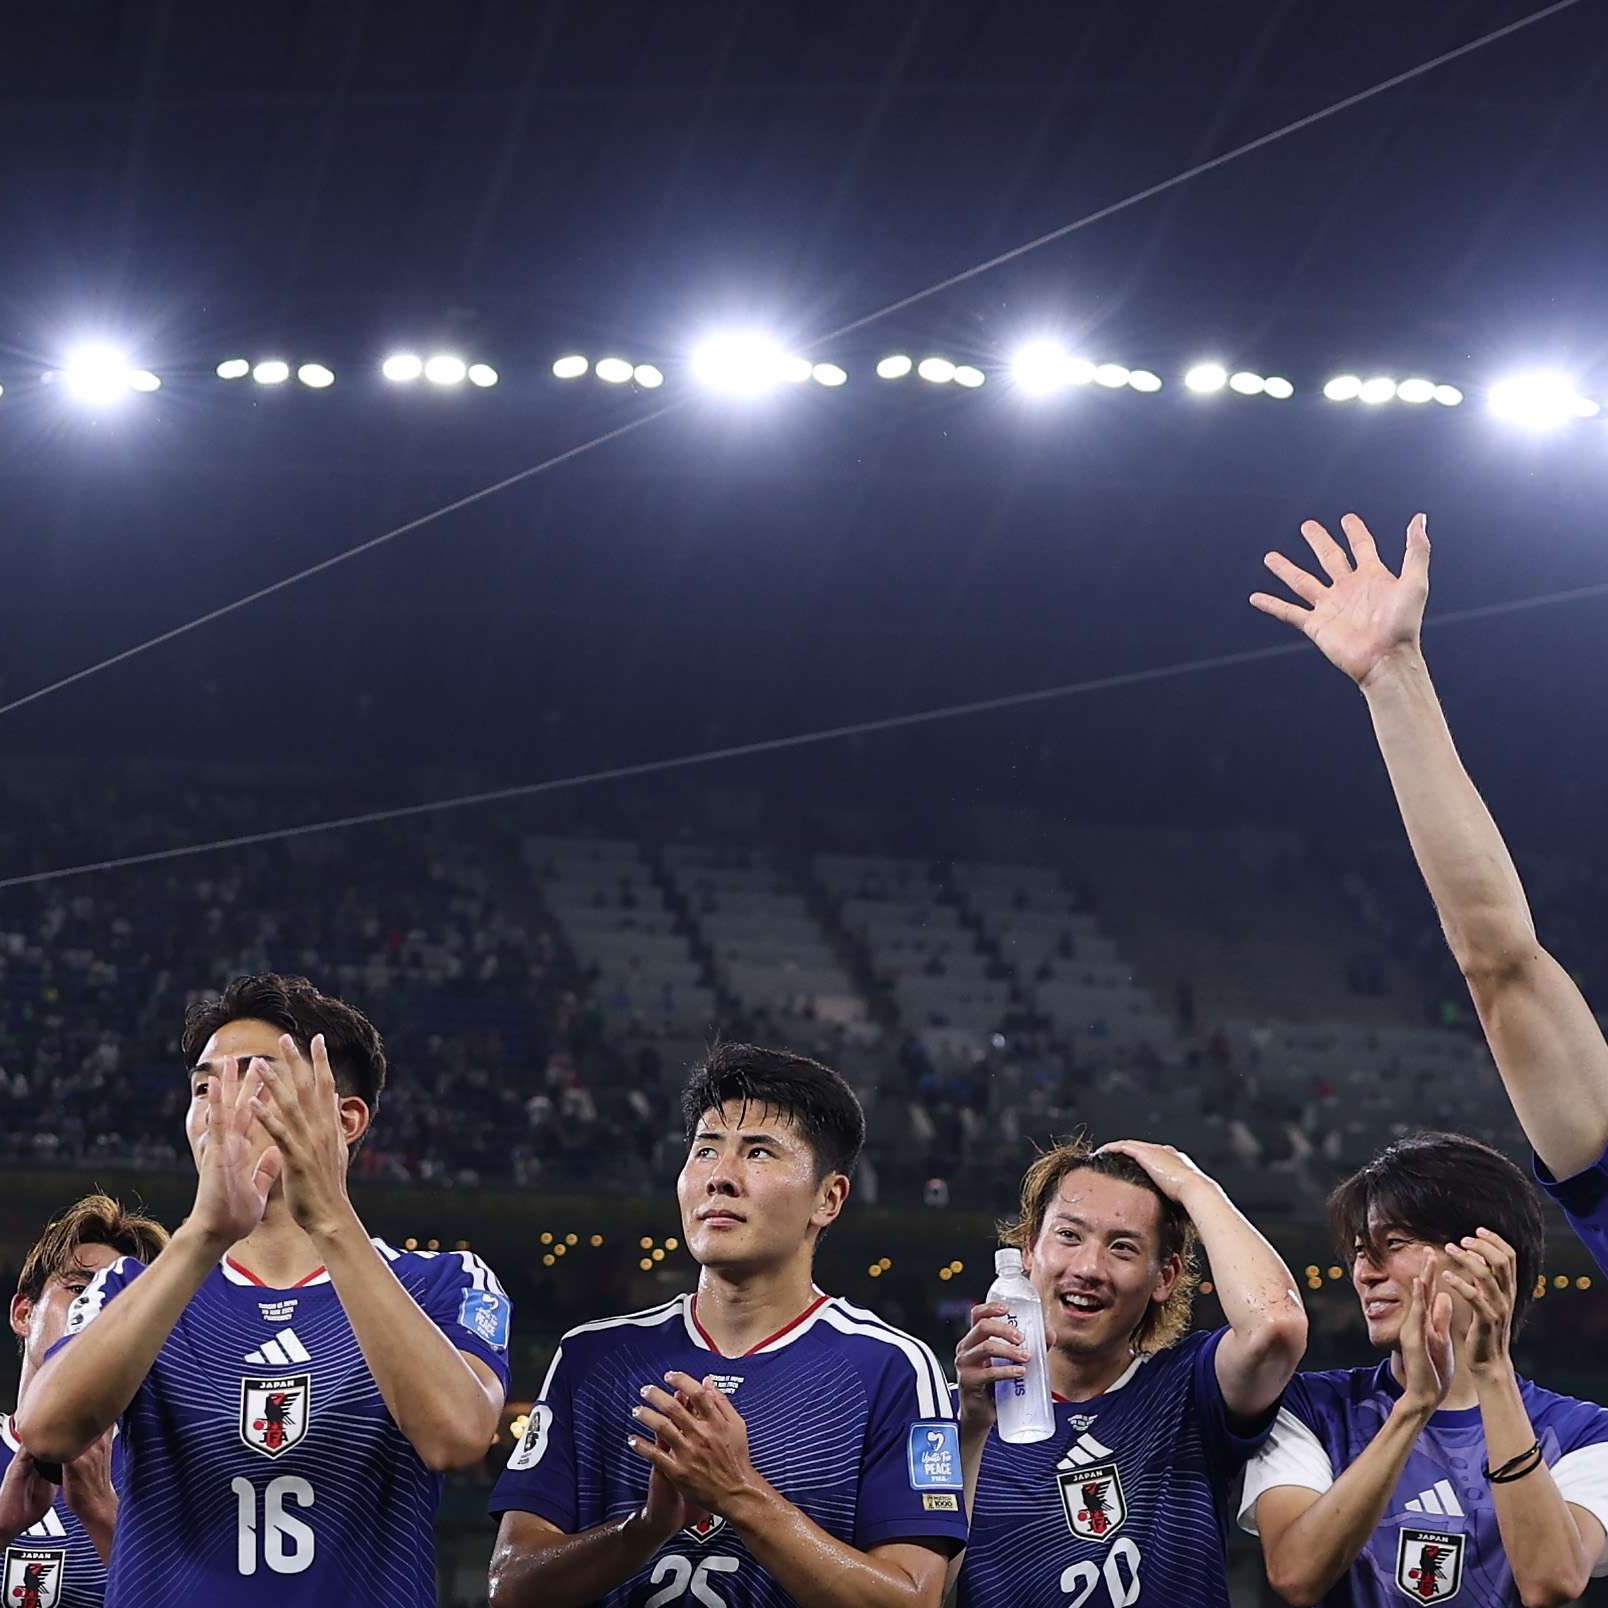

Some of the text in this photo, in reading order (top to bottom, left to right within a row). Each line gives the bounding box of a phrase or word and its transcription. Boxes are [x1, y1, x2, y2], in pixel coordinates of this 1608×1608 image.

[259, 1380, 294, 1390] JAPAN
[925, 1463, 952, 1475] PEACE
[1072, 1470, 1103, 1482] JAPAN
[230, 1475, 315, 1576] 16
[1417, 1533, 1449, 1543] JAPAN
[21, 1552, 51, 1560] JAPAN
